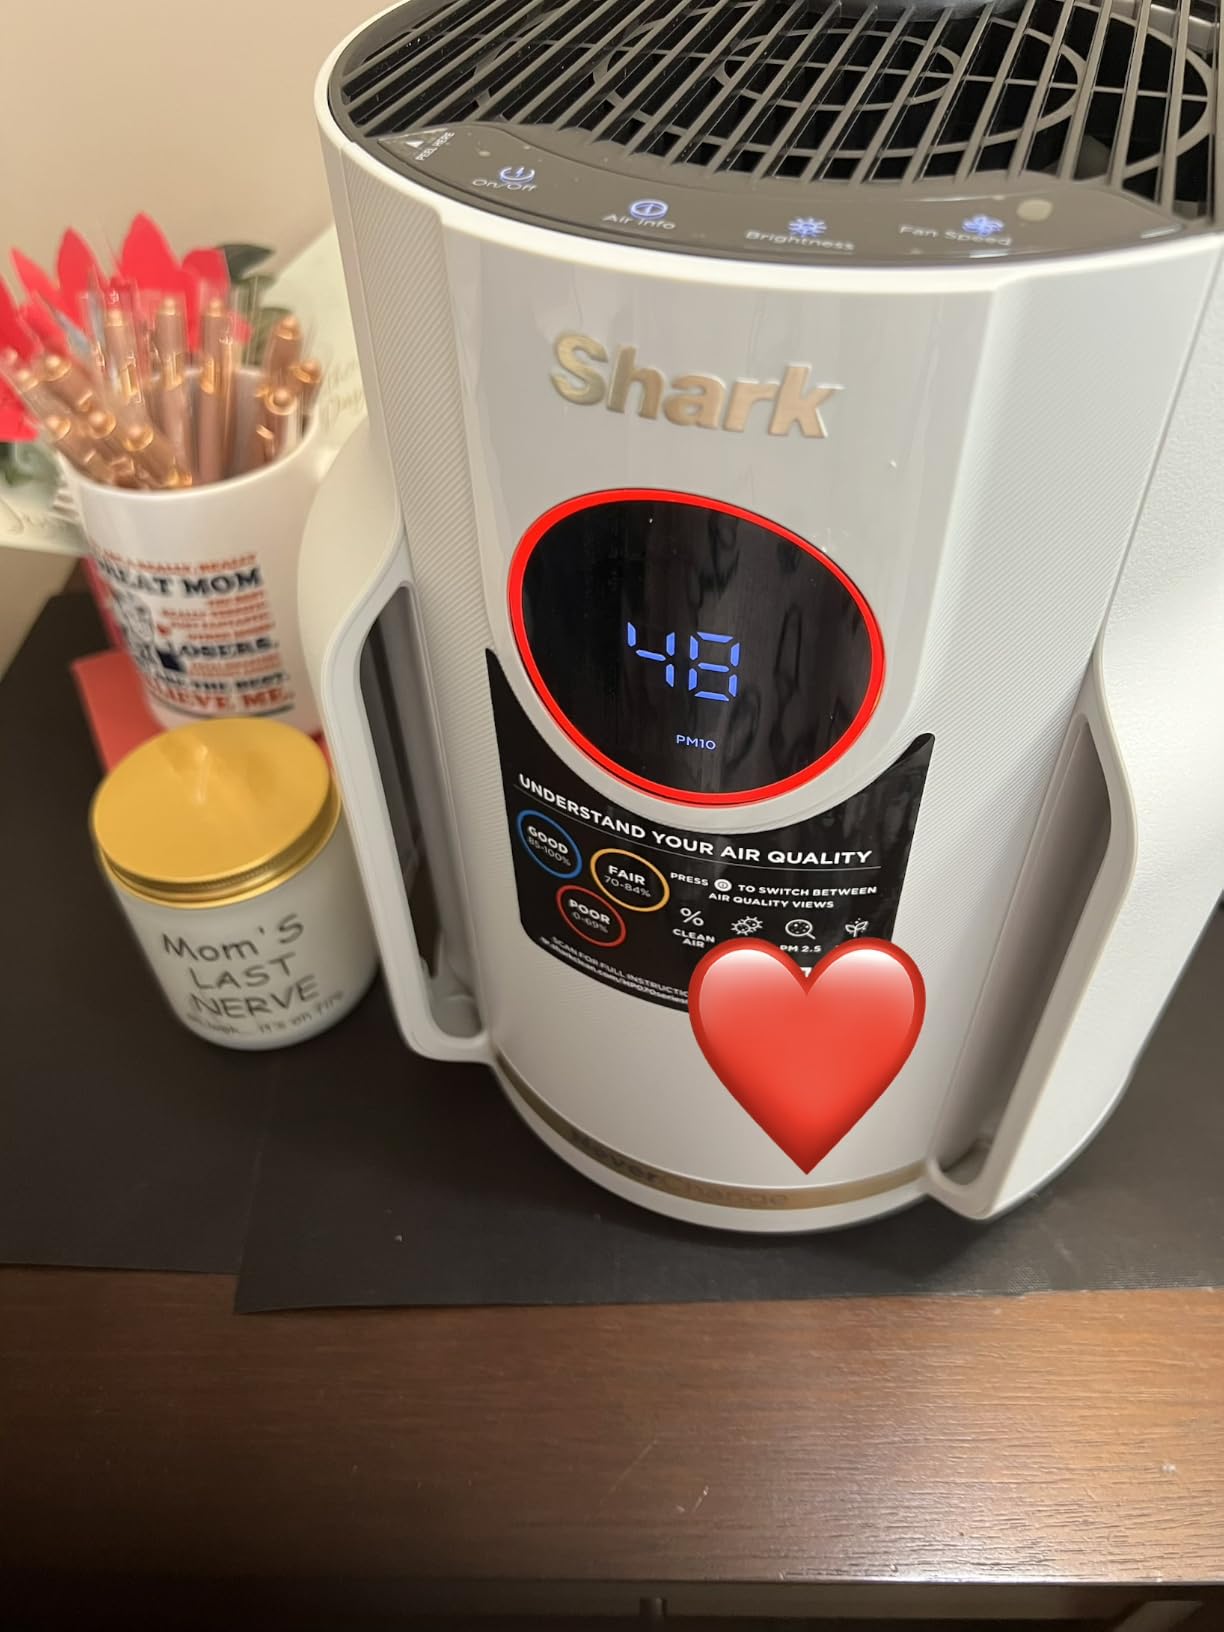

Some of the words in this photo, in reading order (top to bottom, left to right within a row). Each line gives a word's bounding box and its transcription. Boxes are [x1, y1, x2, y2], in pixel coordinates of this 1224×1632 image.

[472, 178, 537, 192] On/Off
[602, 214, 632, 224] Air
[745, 229, 855, 251] Brightness
[900, 225, 937, 239] Fan
[944, 231, 1012, 246] Speed
[551, 333, 845, 438] Shark
[182, 567, 262, 596] MOM
[627, 622, 740, 701] 48
[675, 734, 717, 750] PM10
[519, 773, 646, 839] UNDERSTAND
[651, 831, 714, 856] YOUR
[721, 847, 760, 862] AIR
[767, 850, 873, 865] QUALITY
[527, 826, 569, 855] GOOD
[527, 836, 571, 867] 85-100%
[604, 875, 651, 898] 70-84%
[608, 865, 646, 886] FAIR
[670, 872, 709, 886] PRESS
[738, 884, 756, 893] TO
[758, 886, 809, 897] SWITCH
[812, 886, 877, 897] BETWEEN
[569, 899, 610, 925] POOR
[708, 892, 730, 902] AIR
[733, 896, 788, 908] QUALITY
[792, 900, 834, 909] VIEWS
[572, 911, 608, 934] 0-69%
[680, 907, 704, 927] %
[672, 928, 715, 943] CLEAN
[682, 937, 705, 948] AIR
[552, 936, 578, 956] SCAN
[579, 951, 599, 966] FOR
[600, 961, 625, 978] FULL
[780, 944, 799, 952] PM
[801, 945, 822, 953] 2.5
[189, 952, 296, 990] LAST
[190, 974, 320, 1019] NERVE
